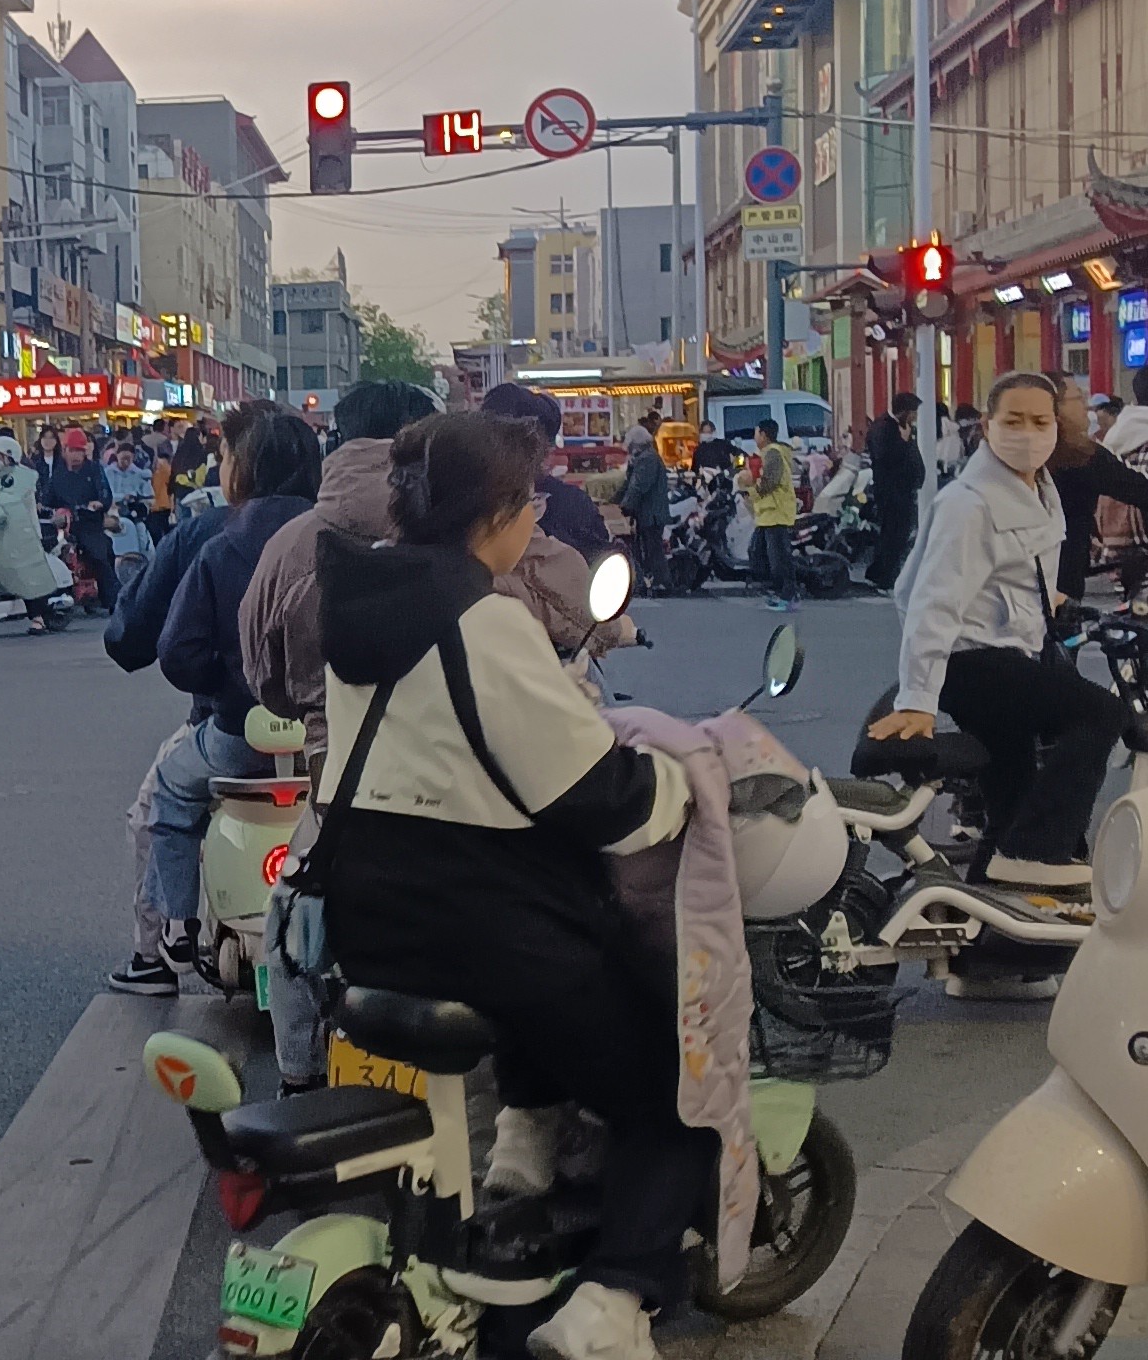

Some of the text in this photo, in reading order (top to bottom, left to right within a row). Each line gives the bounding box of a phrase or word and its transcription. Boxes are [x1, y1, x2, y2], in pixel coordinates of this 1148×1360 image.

[443, 112, 480, 153] 14
[14, 381, 102, 400] 中国福利彩票
